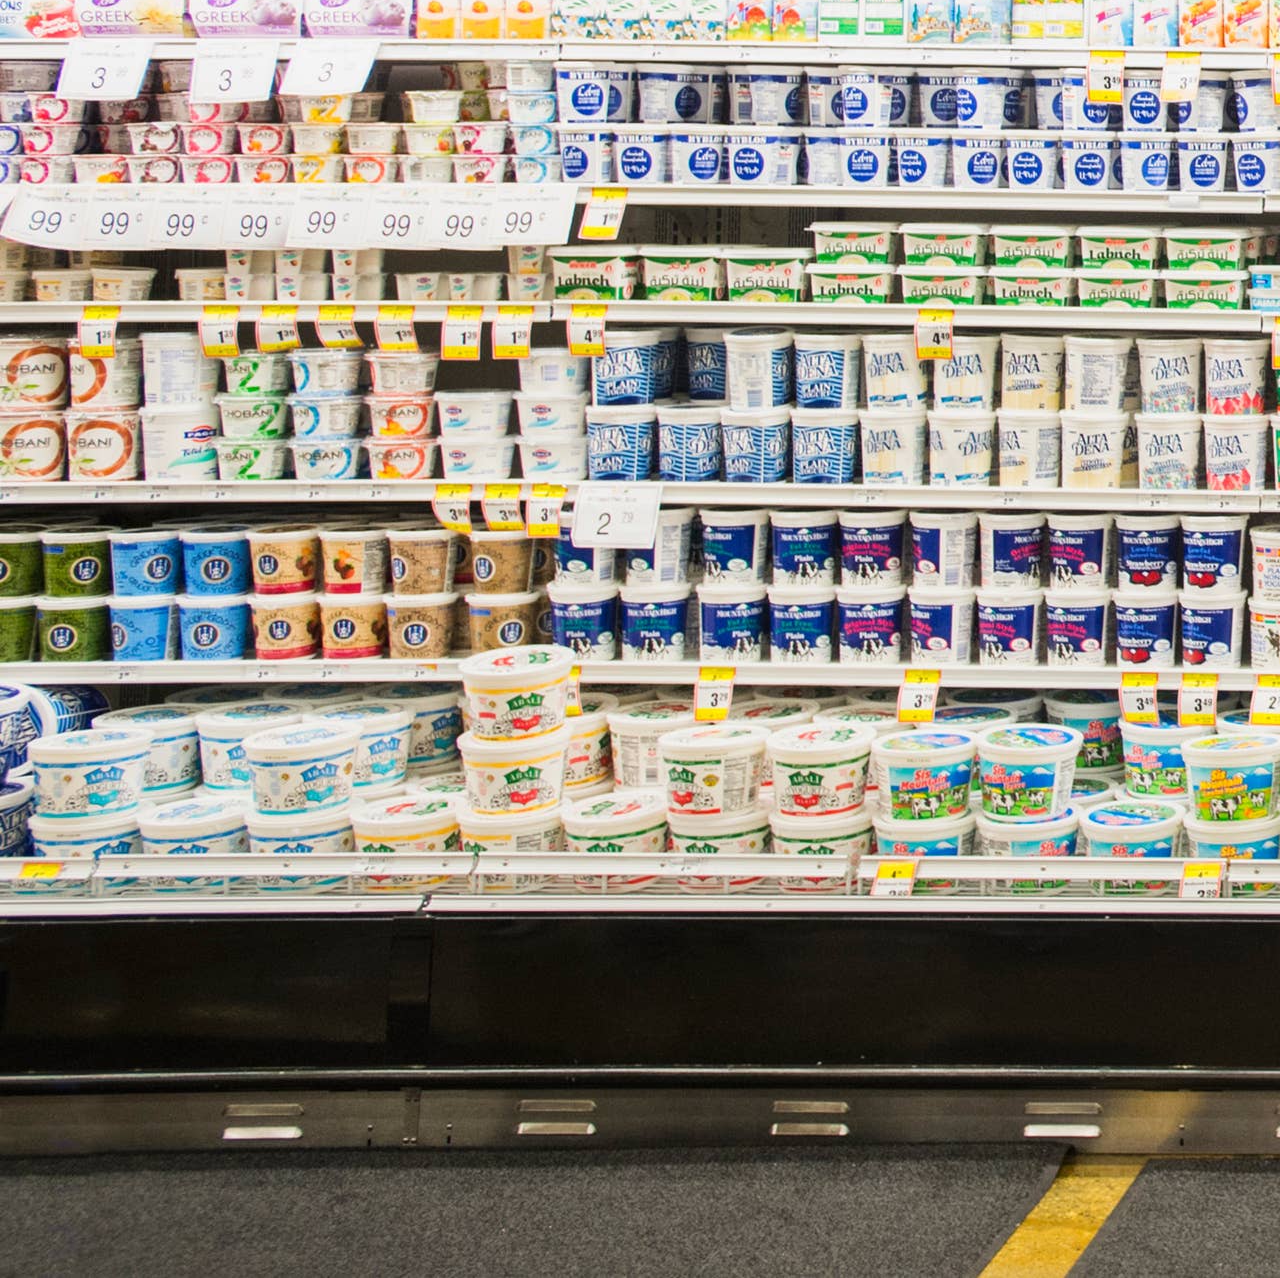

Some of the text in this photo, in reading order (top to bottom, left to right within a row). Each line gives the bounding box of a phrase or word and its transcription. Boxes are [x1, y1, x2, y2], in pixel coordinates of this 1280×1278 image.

[80, 10, 136, 23] GREEK
[195, 10, 252, 23] GREEK
[308, 10, 361, 23] GREEK
[91, 66, 107, 90] 3
[318, 62, 334, 83] 3
[218, 69, 233, 91] 3
[1188, 141, 1223, 150] BYBLOS
[28, 210, 62, 234] 99
[100, 212, 130, 235] 99
[166, 213, 195, 237] 99
[239, 214, 268, 237] 99
[306, 211, 336, 234] 99
[381, 214, 411, 237] 99
[444, 215, 474, 238] 99
[504, 211, 533, 234] 99
[1007, 362, 1042, 376] DENA
[1154, 367, 1191, 381] DENA
[1072, 443, 1110, 456] DENA
[1145, 444, 1184, 458] DENA
[596, 512, 612, 535] 2
[640, 630, 660, 639] Plain
[732, 630, 751, 639] Plain
[511, 696, 543, 709] ABALI
[304, 767, 339, 780] ABALI
[507, 769, 541, 782] ABALI
[914, 769, 931, 781] Sis
